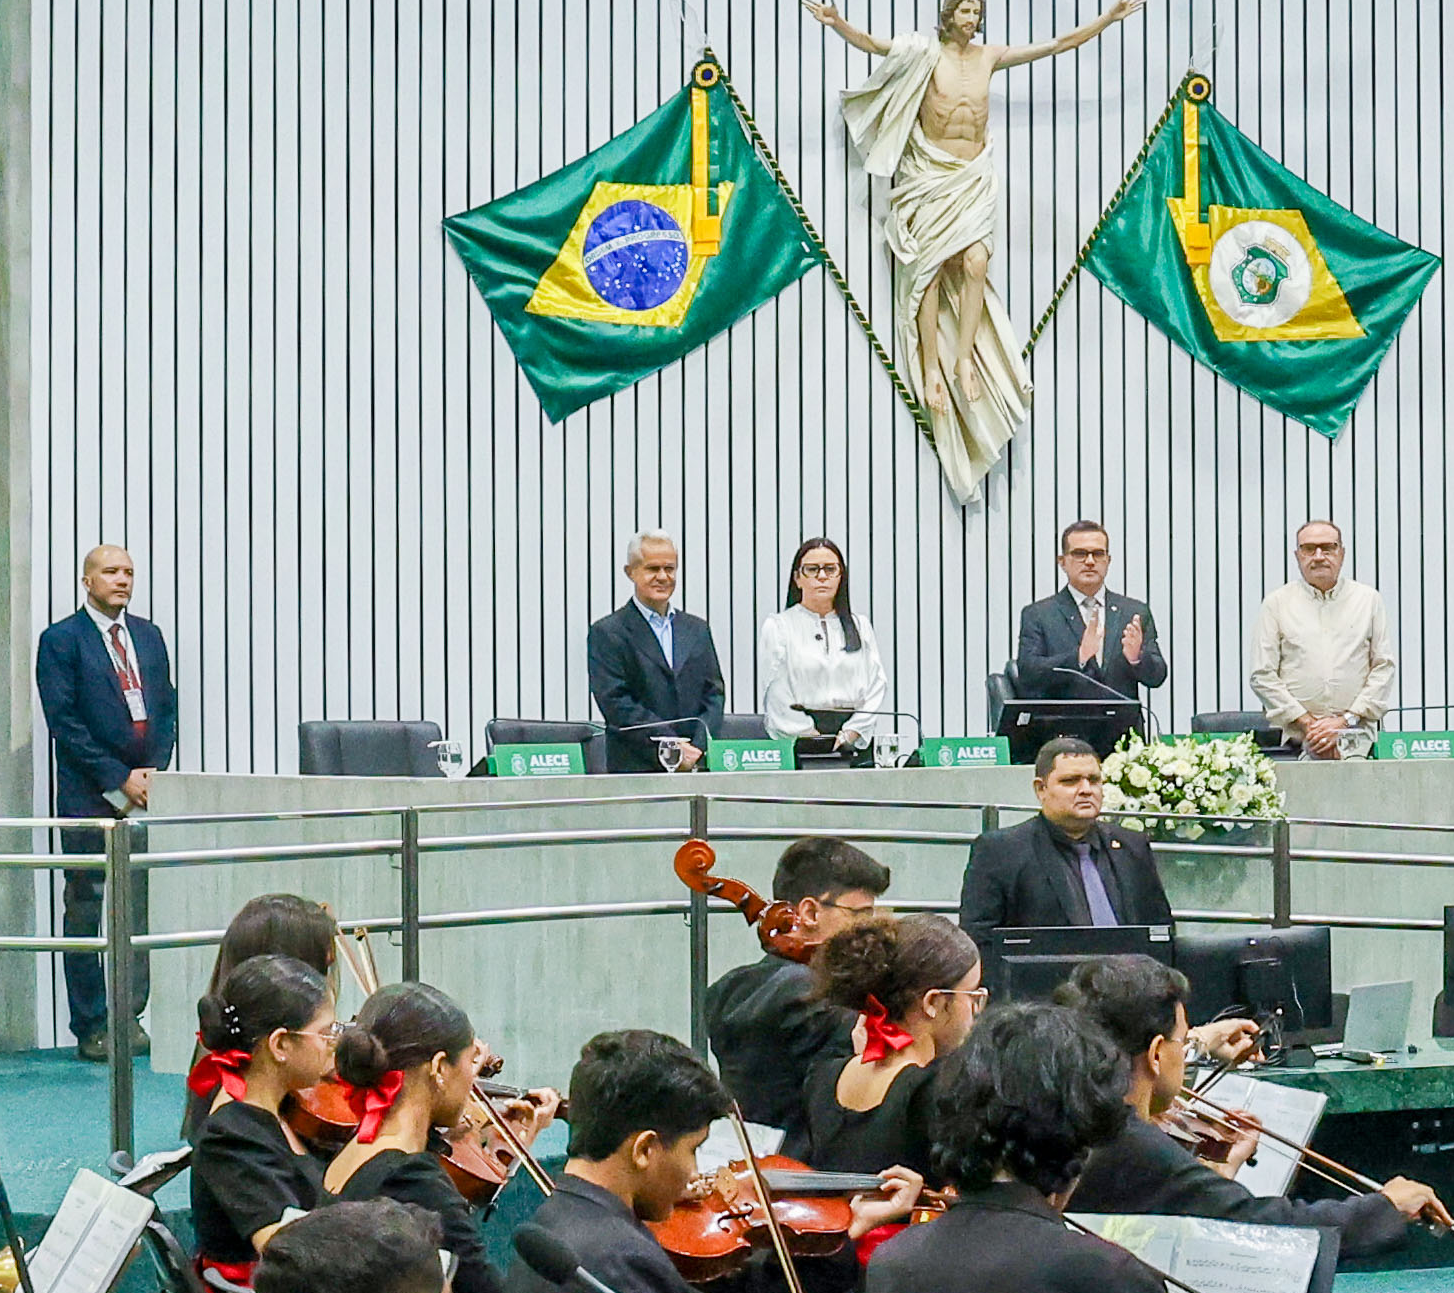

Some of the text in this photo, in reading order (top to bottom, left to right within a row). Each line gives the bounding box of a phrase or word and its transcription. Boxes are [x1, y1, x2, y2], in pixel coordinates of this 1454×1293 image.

[1411, 739, 1451, 752] ALECE
[741, 750, 782, 763] ALECE
[957, 746, 997, 759] ALECE
[530, 754, 570, 767] ALECE
